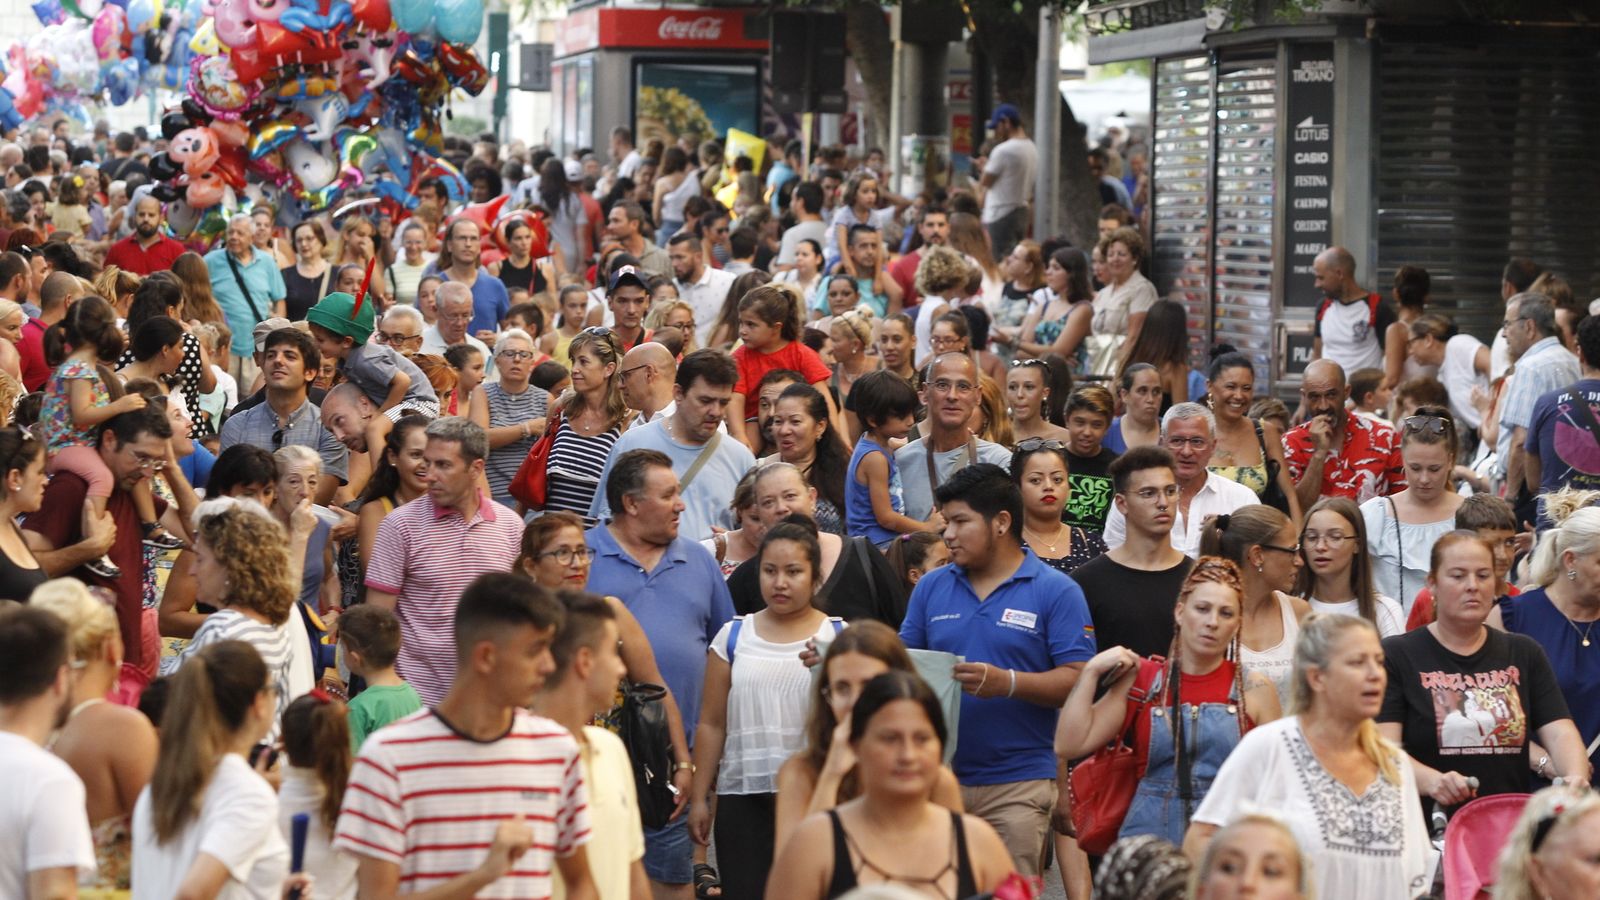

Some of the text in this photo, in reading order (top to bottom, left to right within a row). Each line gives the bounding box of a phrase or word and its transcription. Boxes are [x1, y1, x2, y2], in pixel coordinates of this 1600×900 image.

[658, 16, 723, 39] Coca-Cola
[1293, 69, 1334, 81] TROYANO
[1295, 128, 1329, 141] LOTUS
[1294, 152, 1329, 164] CASIO
[1294, 175, 1328, 187] FESTINA
[1294, 197, 1328, 209] CALYPSO
[1294, 219, 1328, 232] ORIENT
